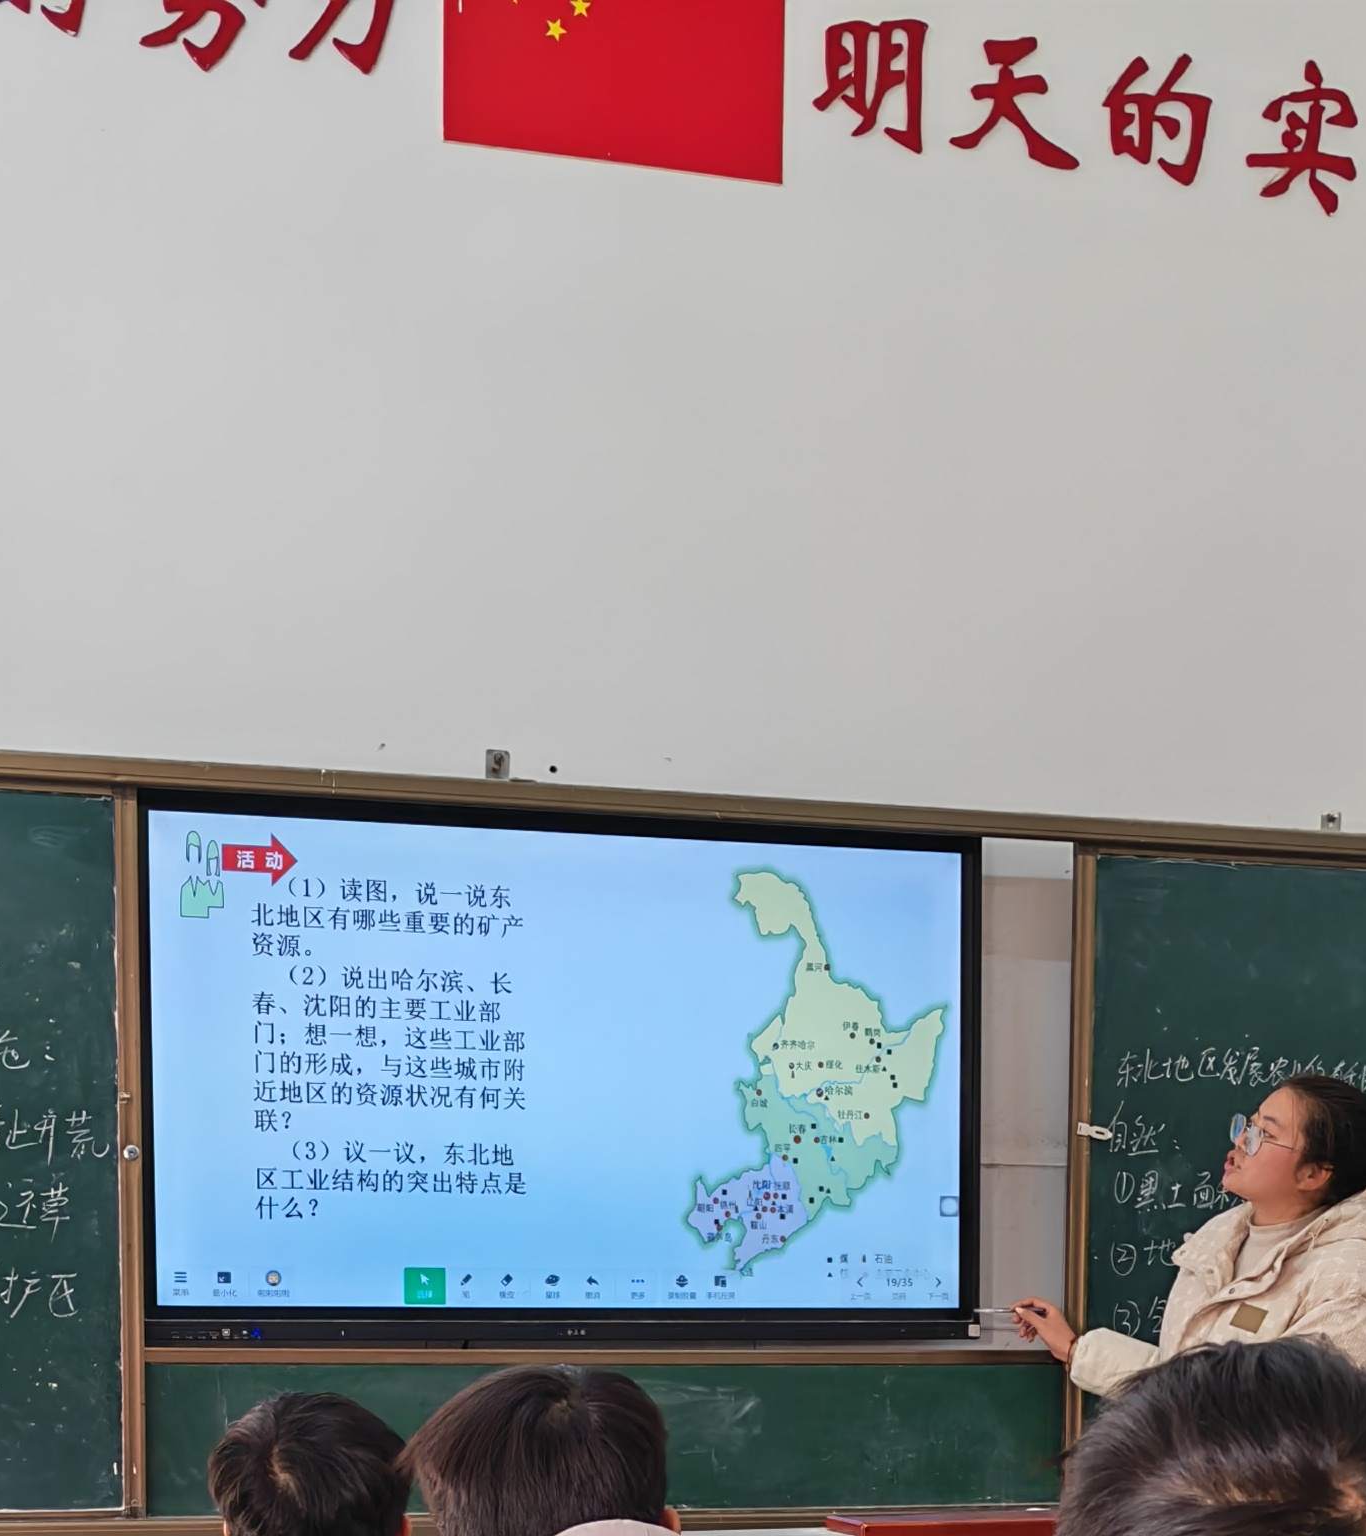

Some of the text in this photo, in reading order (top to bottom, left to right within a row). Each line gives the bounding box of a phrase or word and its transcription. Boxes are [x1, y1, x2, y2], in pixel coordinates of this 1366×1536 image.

[236, 851, 283, 870] 活动
[286, 876, 512, 909] （1）读图，说一说东
[251, 902, 524, 938] 北地区有哪些重要的矿产
[252, 934, 314, 957] 资源。
[288, 966, 513, 993] （2）说出哈尔滨、长
[252, 992, 501, 1024] 春、沈阳的主要工业部
[842, 1021, 859, 1031] 伊春
[254, 1024, 526, 1053] 门；想一想，这些工业部
[781, 1040, 815, 1050] 齐齐哈尔
[254, 1052, 526, 1082] 门的形成，与这些城市附
[796, 1061, 812, 1071] 大庆
[254, 1082, 527, 1111] 近地区的资源状况有何关
[825, 1086, 853, 1096] 哈尔滨
[254, 1109, 293, 1131] 联？
[837, 1110, 864, 1121] 牡丹江
[789, 1123, 806, 1135] 长春
[820, 1135, 837, 1145] 吉林
[291, 1141, 515, 1167] （3）议一议，东北地
[257, 1167, 527, 1196] 区工业结构的突出特点是
[257, 1197, 320, 1220] 什么？
[874, 1254, 894, 1265] 石油
[886, 1277, 913, 1288] 19/35
